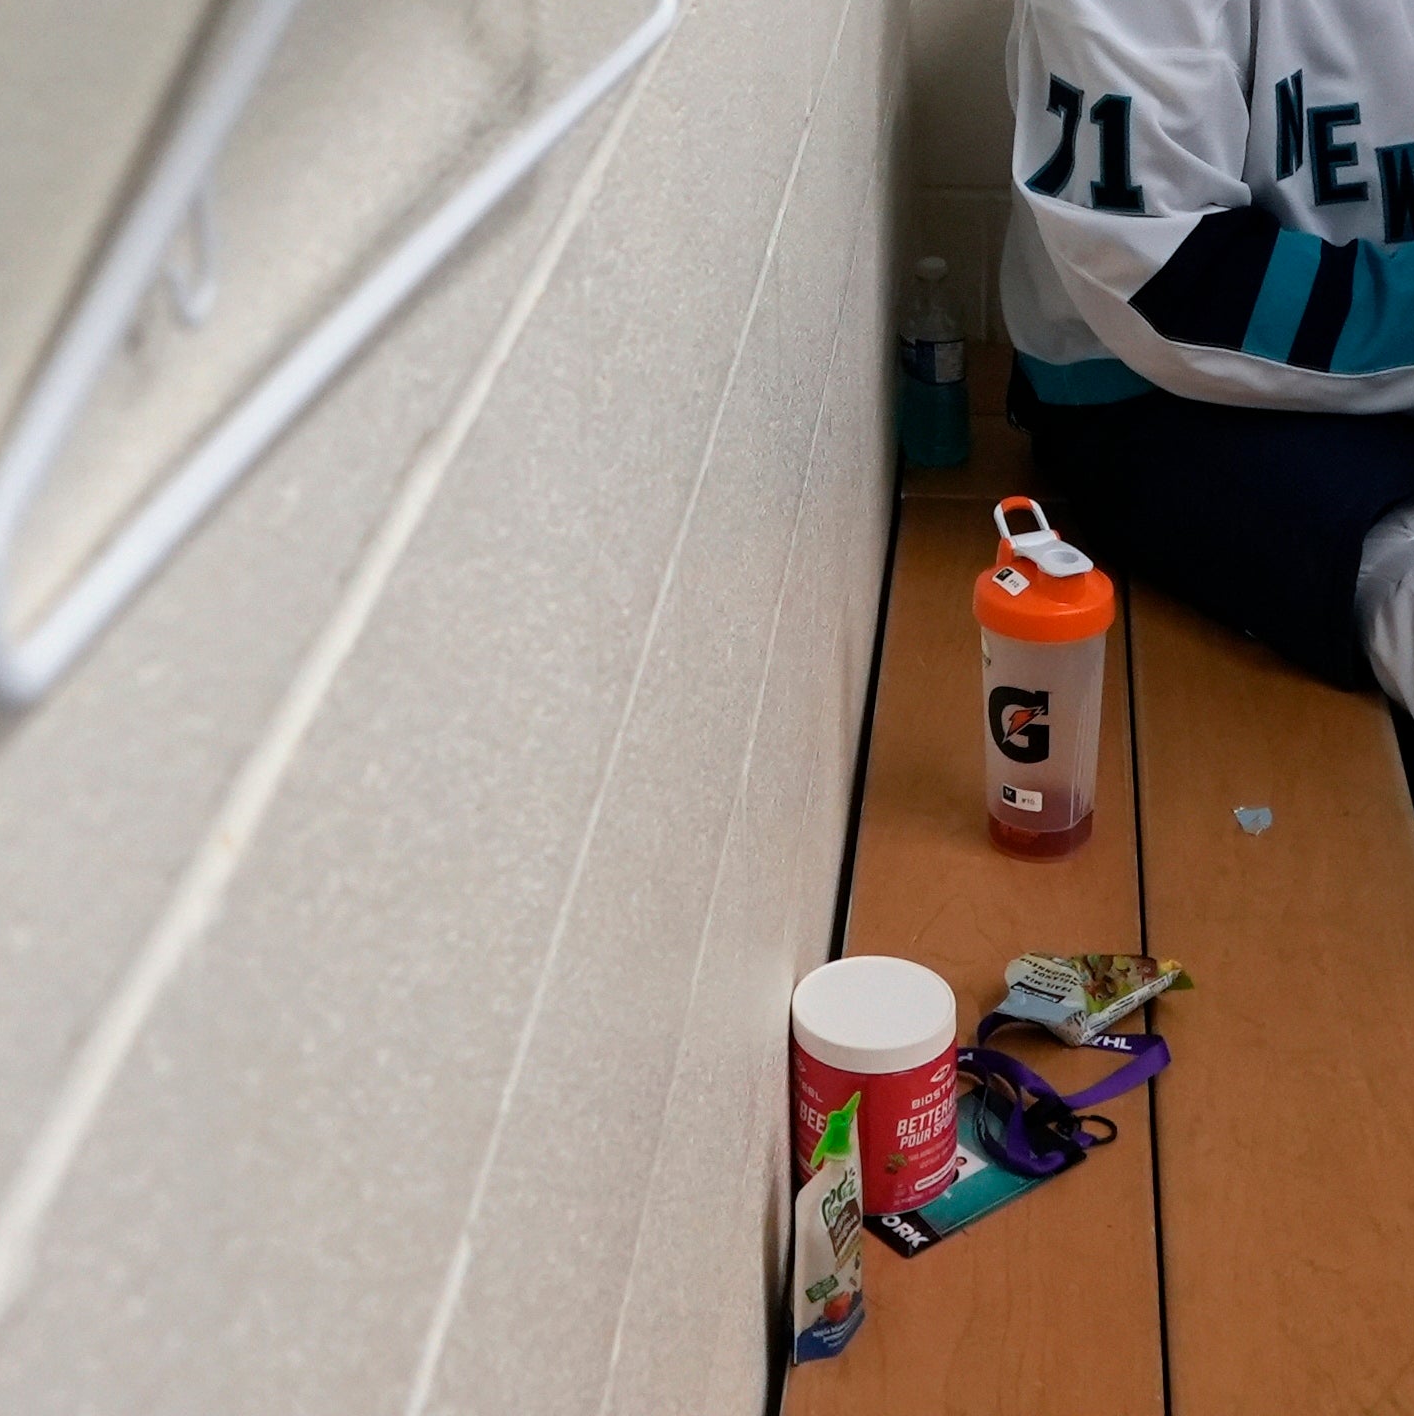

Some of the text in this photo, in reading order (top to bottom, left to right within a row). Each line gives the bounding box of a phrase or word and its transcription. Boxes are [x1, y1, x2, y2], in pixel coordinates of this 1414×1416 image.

[1024, 72, 1146, 214] 71
[988, 686, 1050, 764] G
[799, 1100, 827, 1135] BEE
[899, 1126, 932, 1150] POUR
[881, 1215, 930, 1249] ORK
